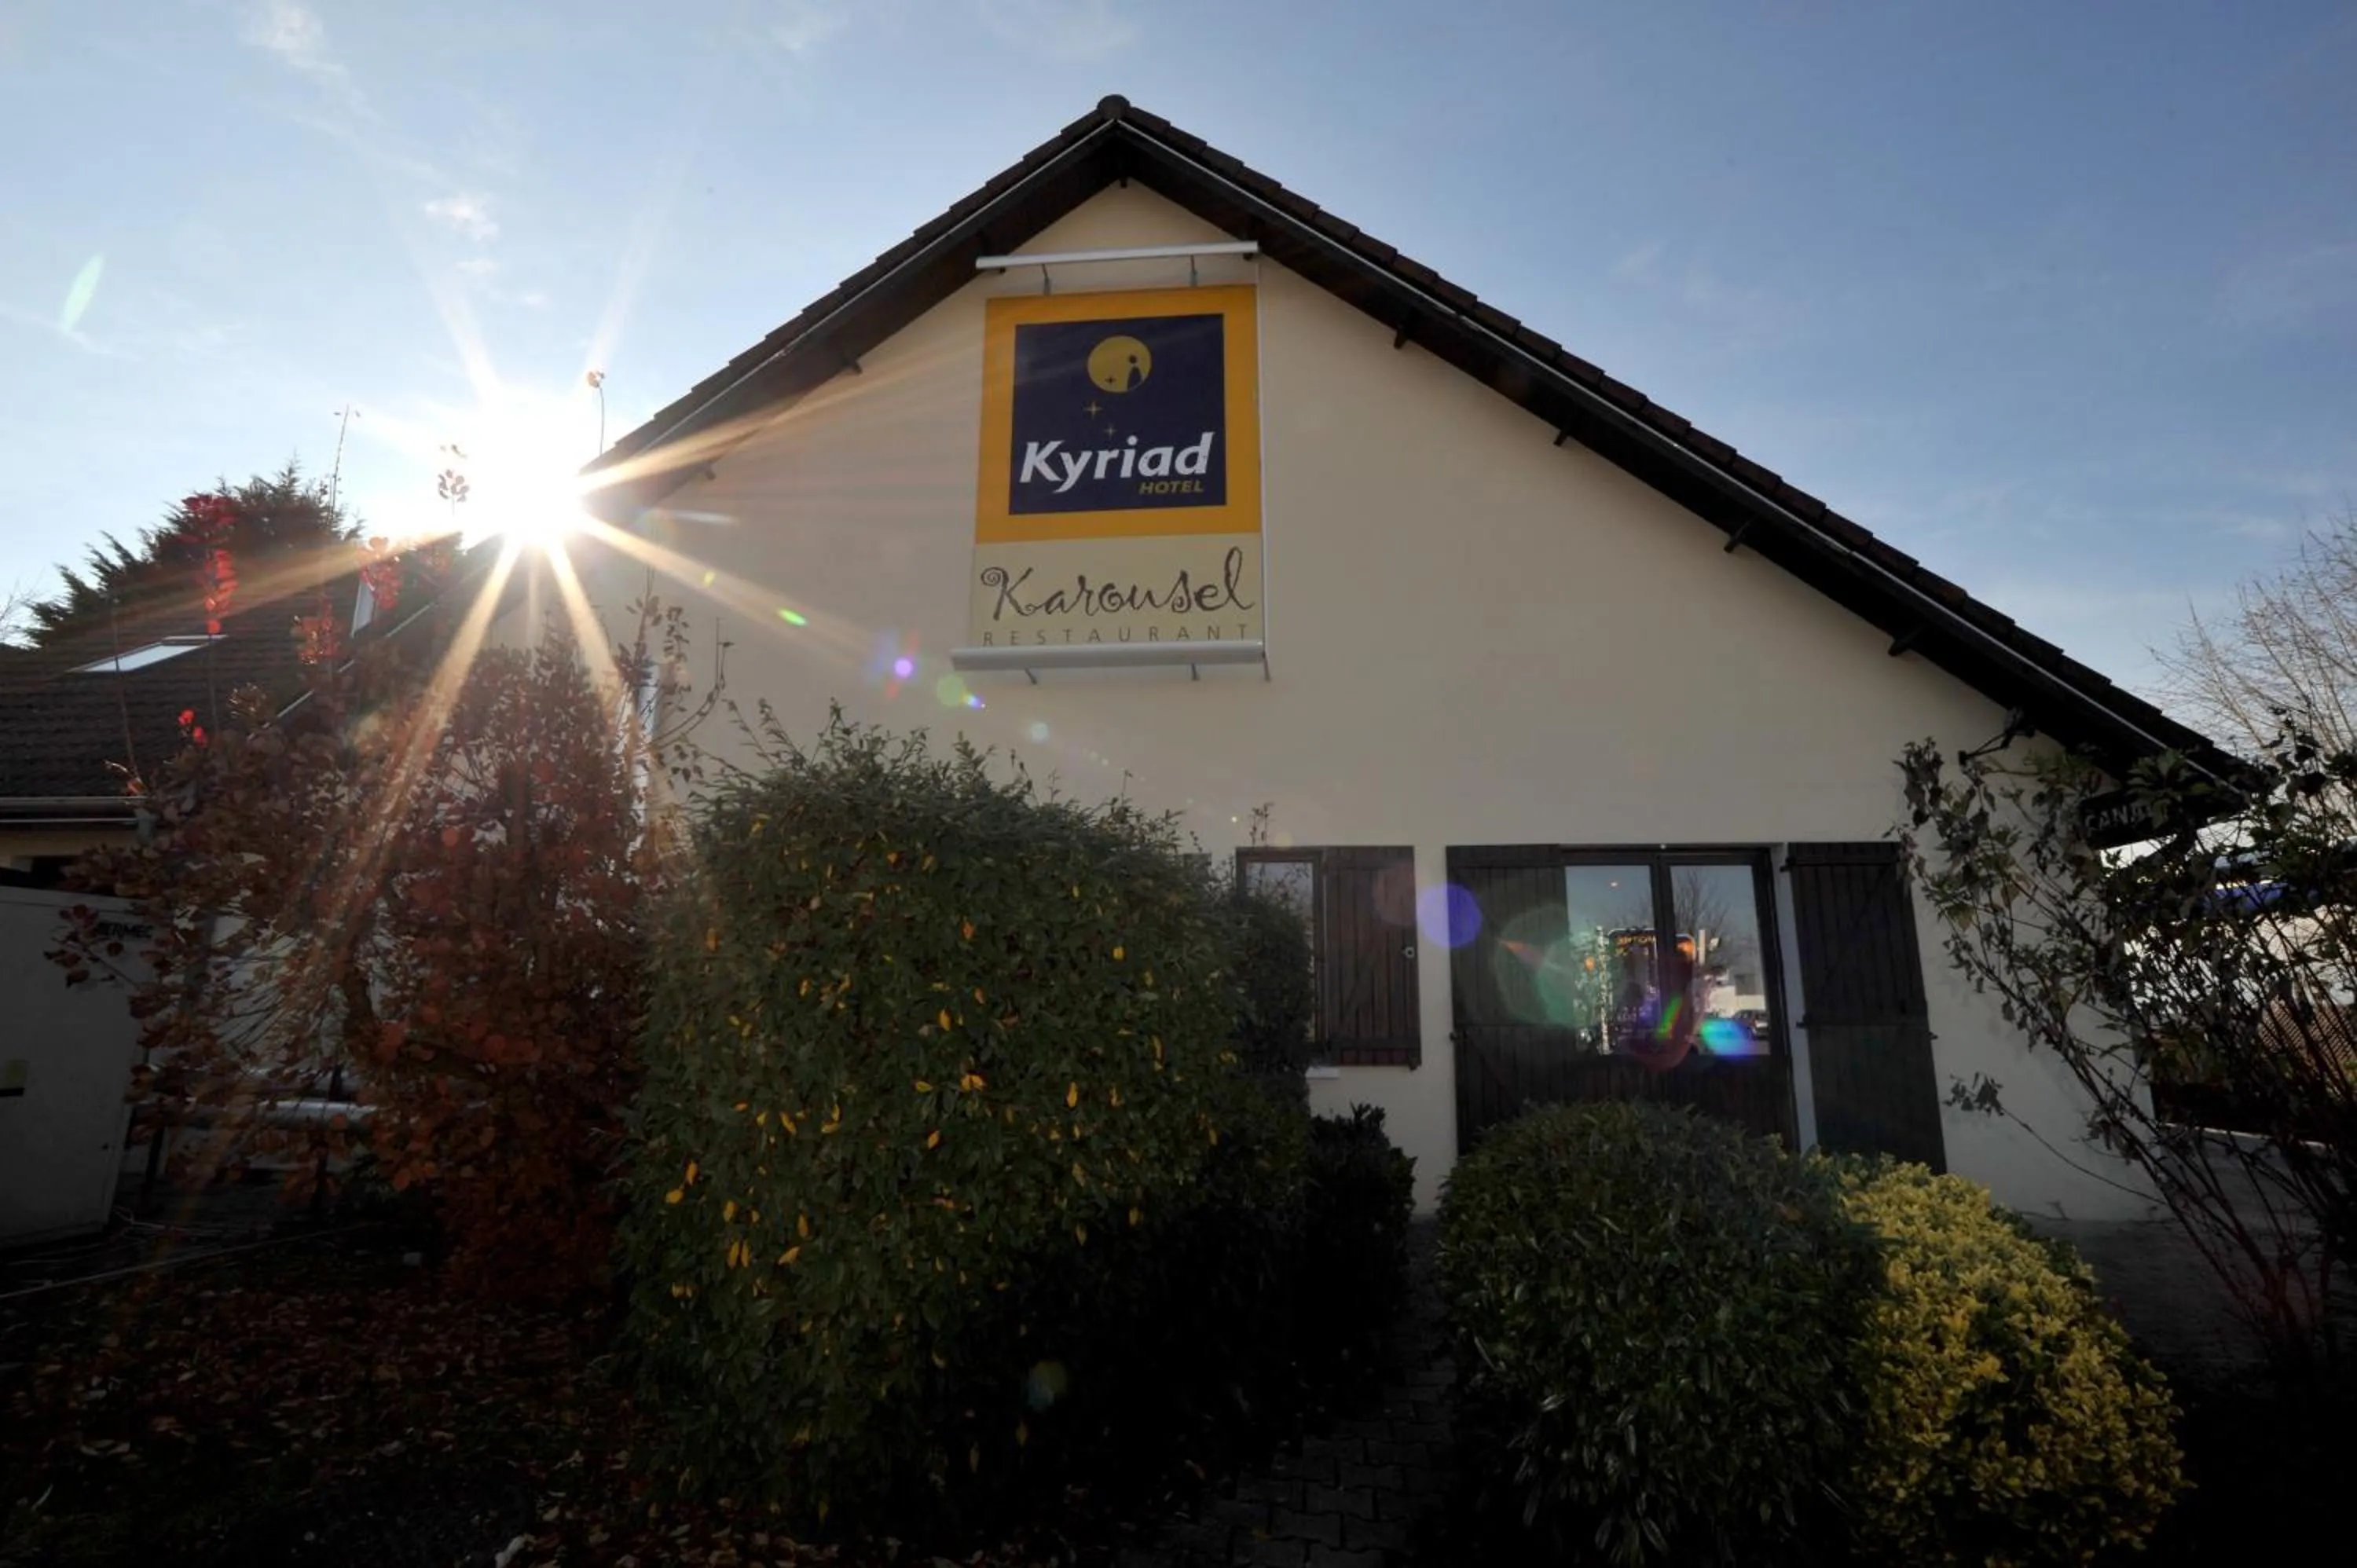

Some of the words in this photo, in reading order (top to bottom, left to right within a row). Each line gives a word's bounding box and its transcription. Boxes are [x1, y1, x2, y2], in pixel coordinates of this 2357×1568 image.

[1019, 431, 1215, 494] Kyriad
[1138, 480, 1204, 495] HOTEL
[981, 546, 1255, 621] Karousel
[982, 624, 1248, 647] RESTAURANT
